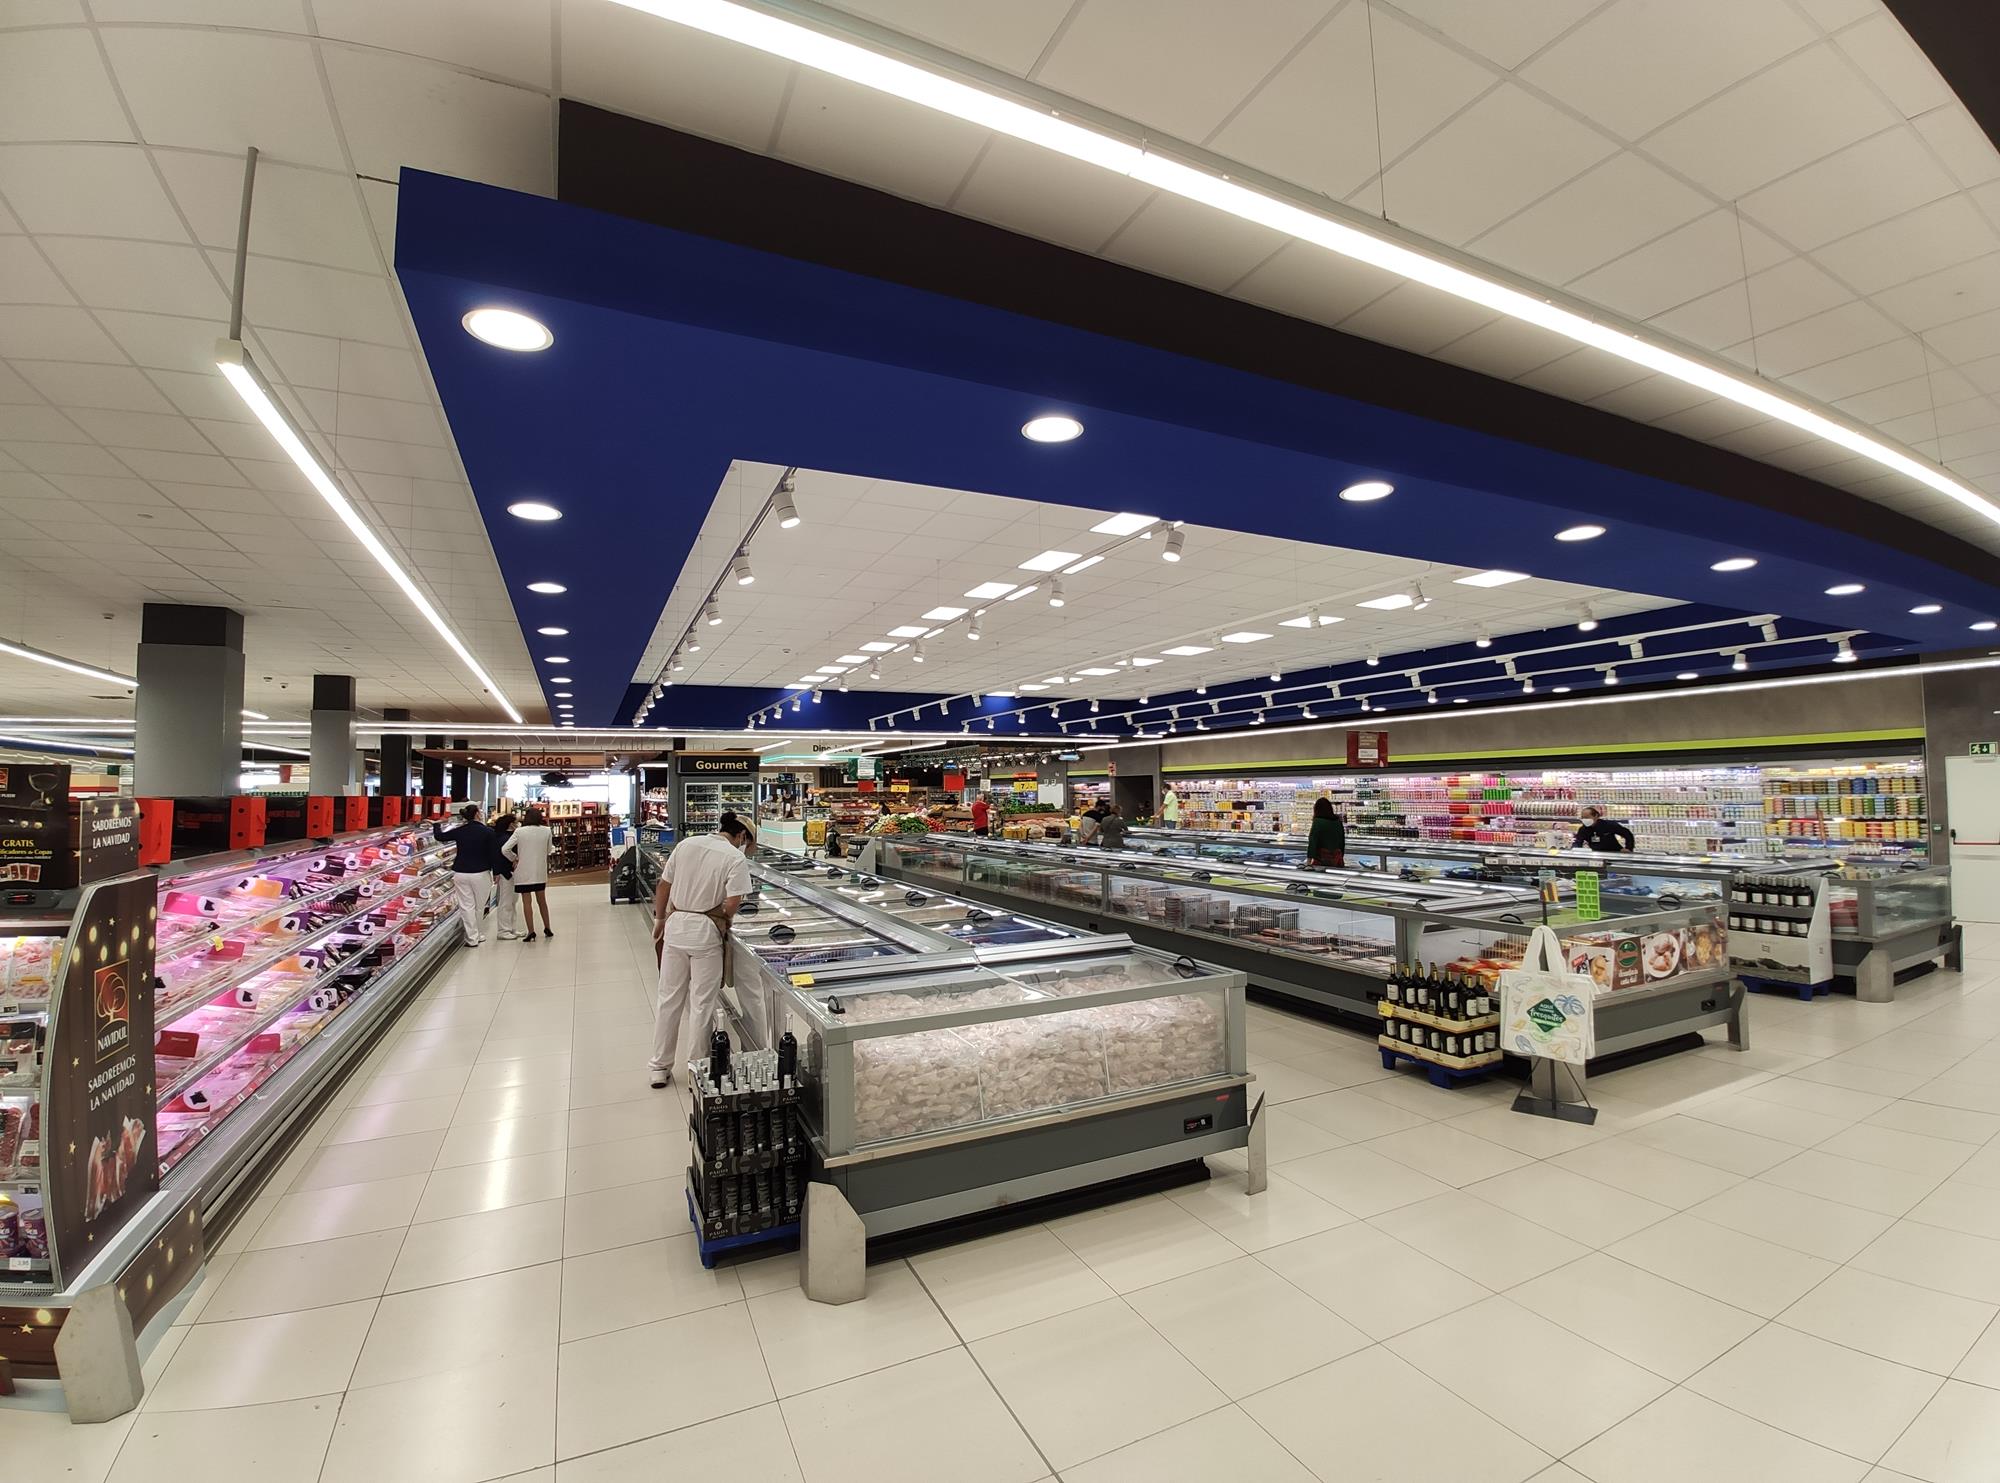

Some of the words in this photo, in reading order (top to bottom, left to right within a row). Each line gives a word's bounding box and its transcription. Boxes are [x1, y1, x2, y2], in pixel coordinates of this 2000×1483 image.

[519, 749, 571, 768] bodega
[695, 760, 748, 770] Gourmet
[92, 816, 132, 833] SABOREEMOS
[2, 839, 34, 848] GRATIS
[92, 837, 101, 849] LA
[102, 832, 131, 847] NAVIDAD
[97, 1025, 128, 1052] NAVIDUL
[88, 1054, 136, 1094] SABOREEMOS
[90, 1095, 101, 1112] LA
[101, 1072, 135, 1104] NAVIDAD
